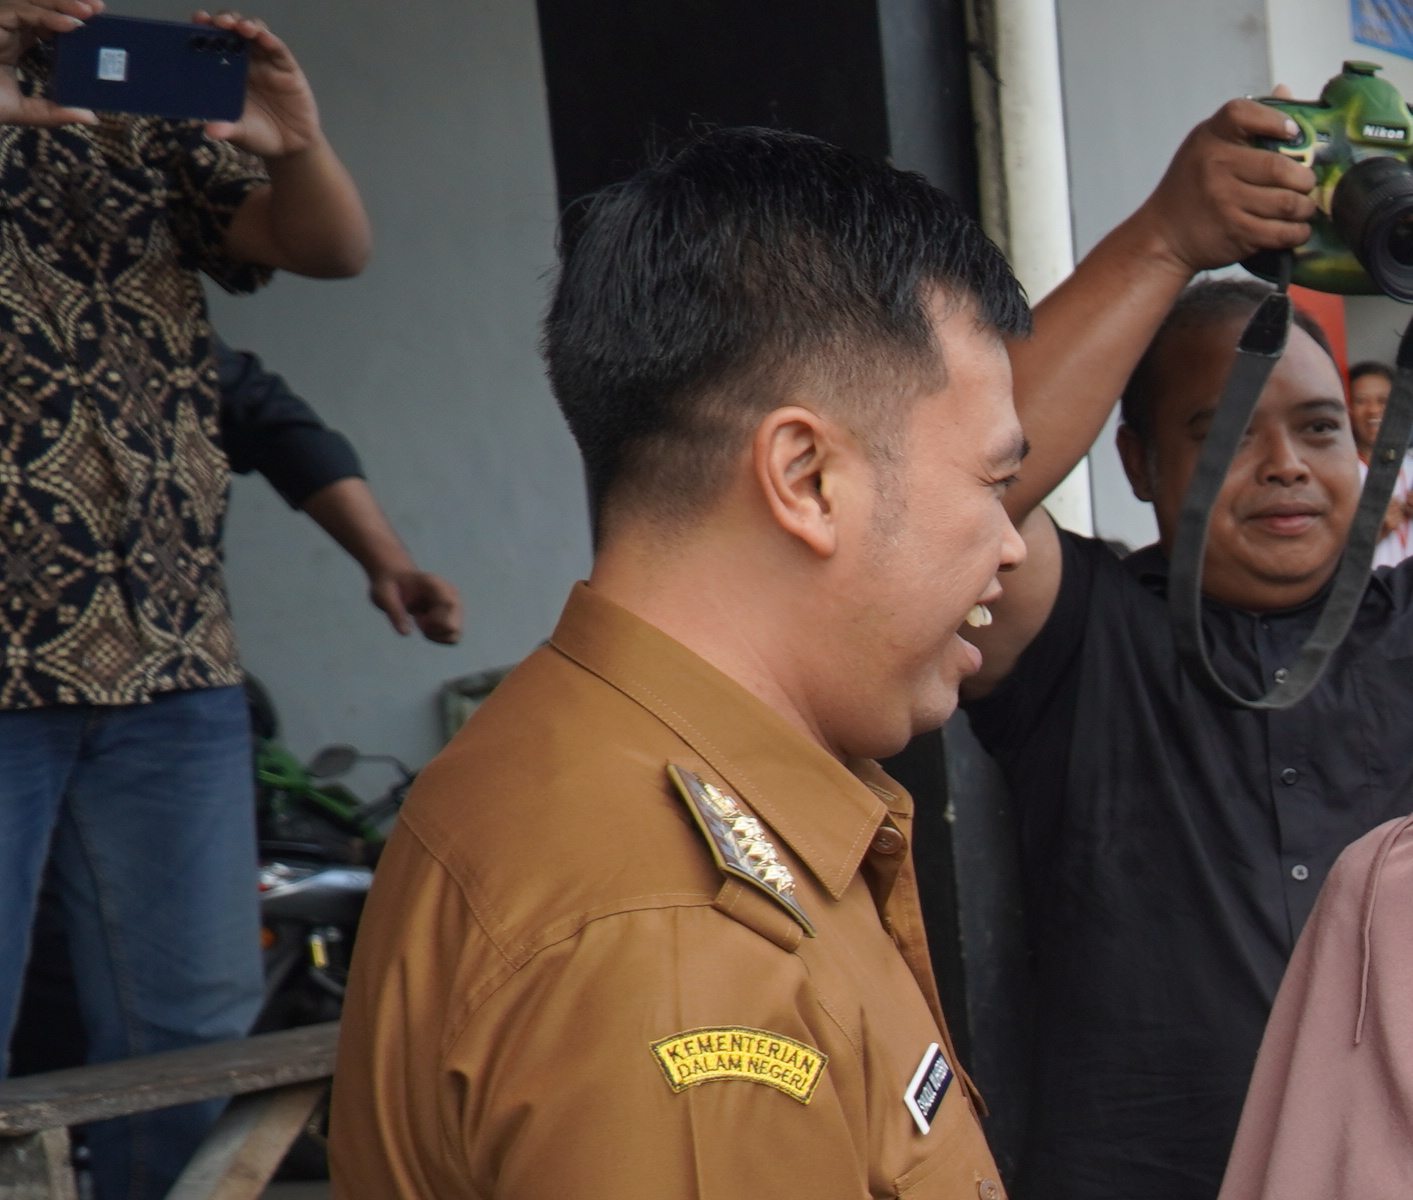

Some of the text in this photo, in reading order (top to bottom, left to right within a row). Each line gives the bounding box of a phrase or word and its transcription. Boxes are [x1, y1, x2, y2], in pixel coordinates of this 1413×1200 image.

[1363, 124, 1405, 140] Nikon
[666, 1032, 815, 1074] KEMENTERIAN
[677, 1055, 808, 1091] DALAM NEGERI
